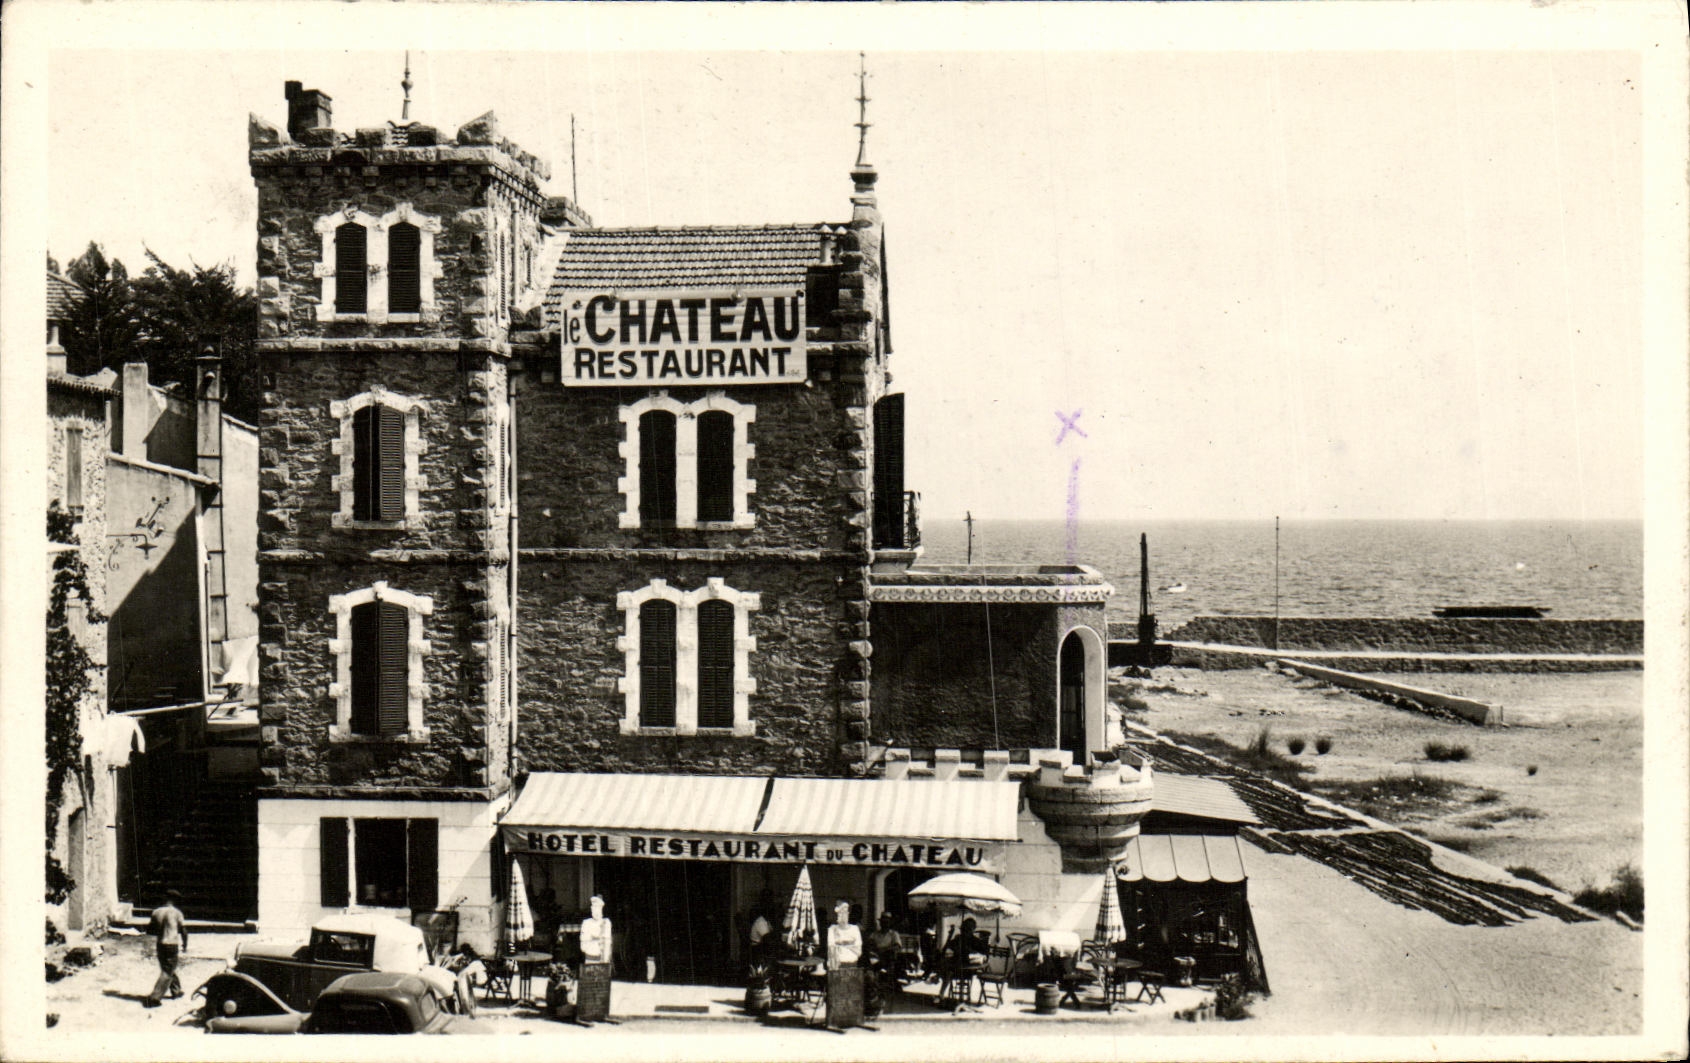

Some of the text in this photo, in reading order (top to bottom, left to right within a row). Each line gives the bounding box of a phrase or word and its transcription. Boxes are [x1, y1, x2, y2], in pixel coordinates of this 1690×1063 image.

[584, 295, 801, 345] CHATEAU
[574, 347, 792, 380] RESTAURANT
[527, 832, 984, 866] HOTEL RESTAURANT DU CHATEAU
